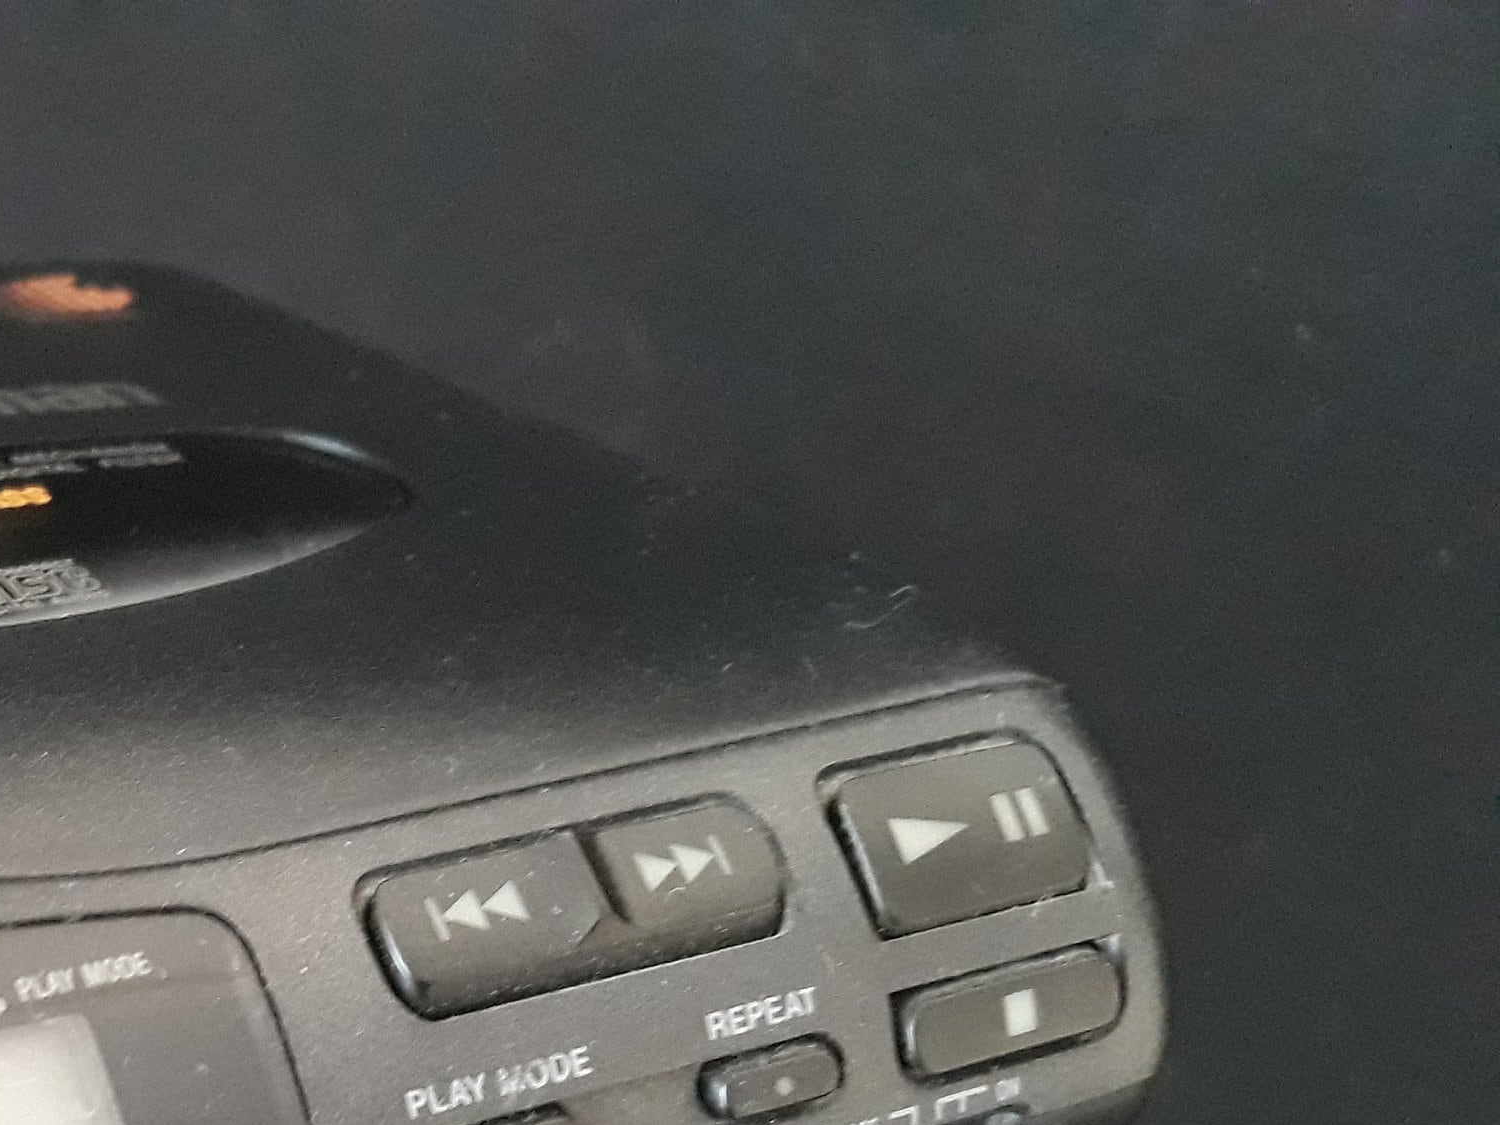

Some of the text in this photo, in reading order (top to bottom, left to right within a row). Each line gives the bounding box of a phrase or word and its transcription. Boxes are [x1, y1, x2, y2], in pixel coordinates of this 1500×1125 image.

[13, 950, 153, 1003] PLAY MODE
[703, 985, 819, 1041] REPEAT
[402, 1043, 597, 1120] PLAY MODE
